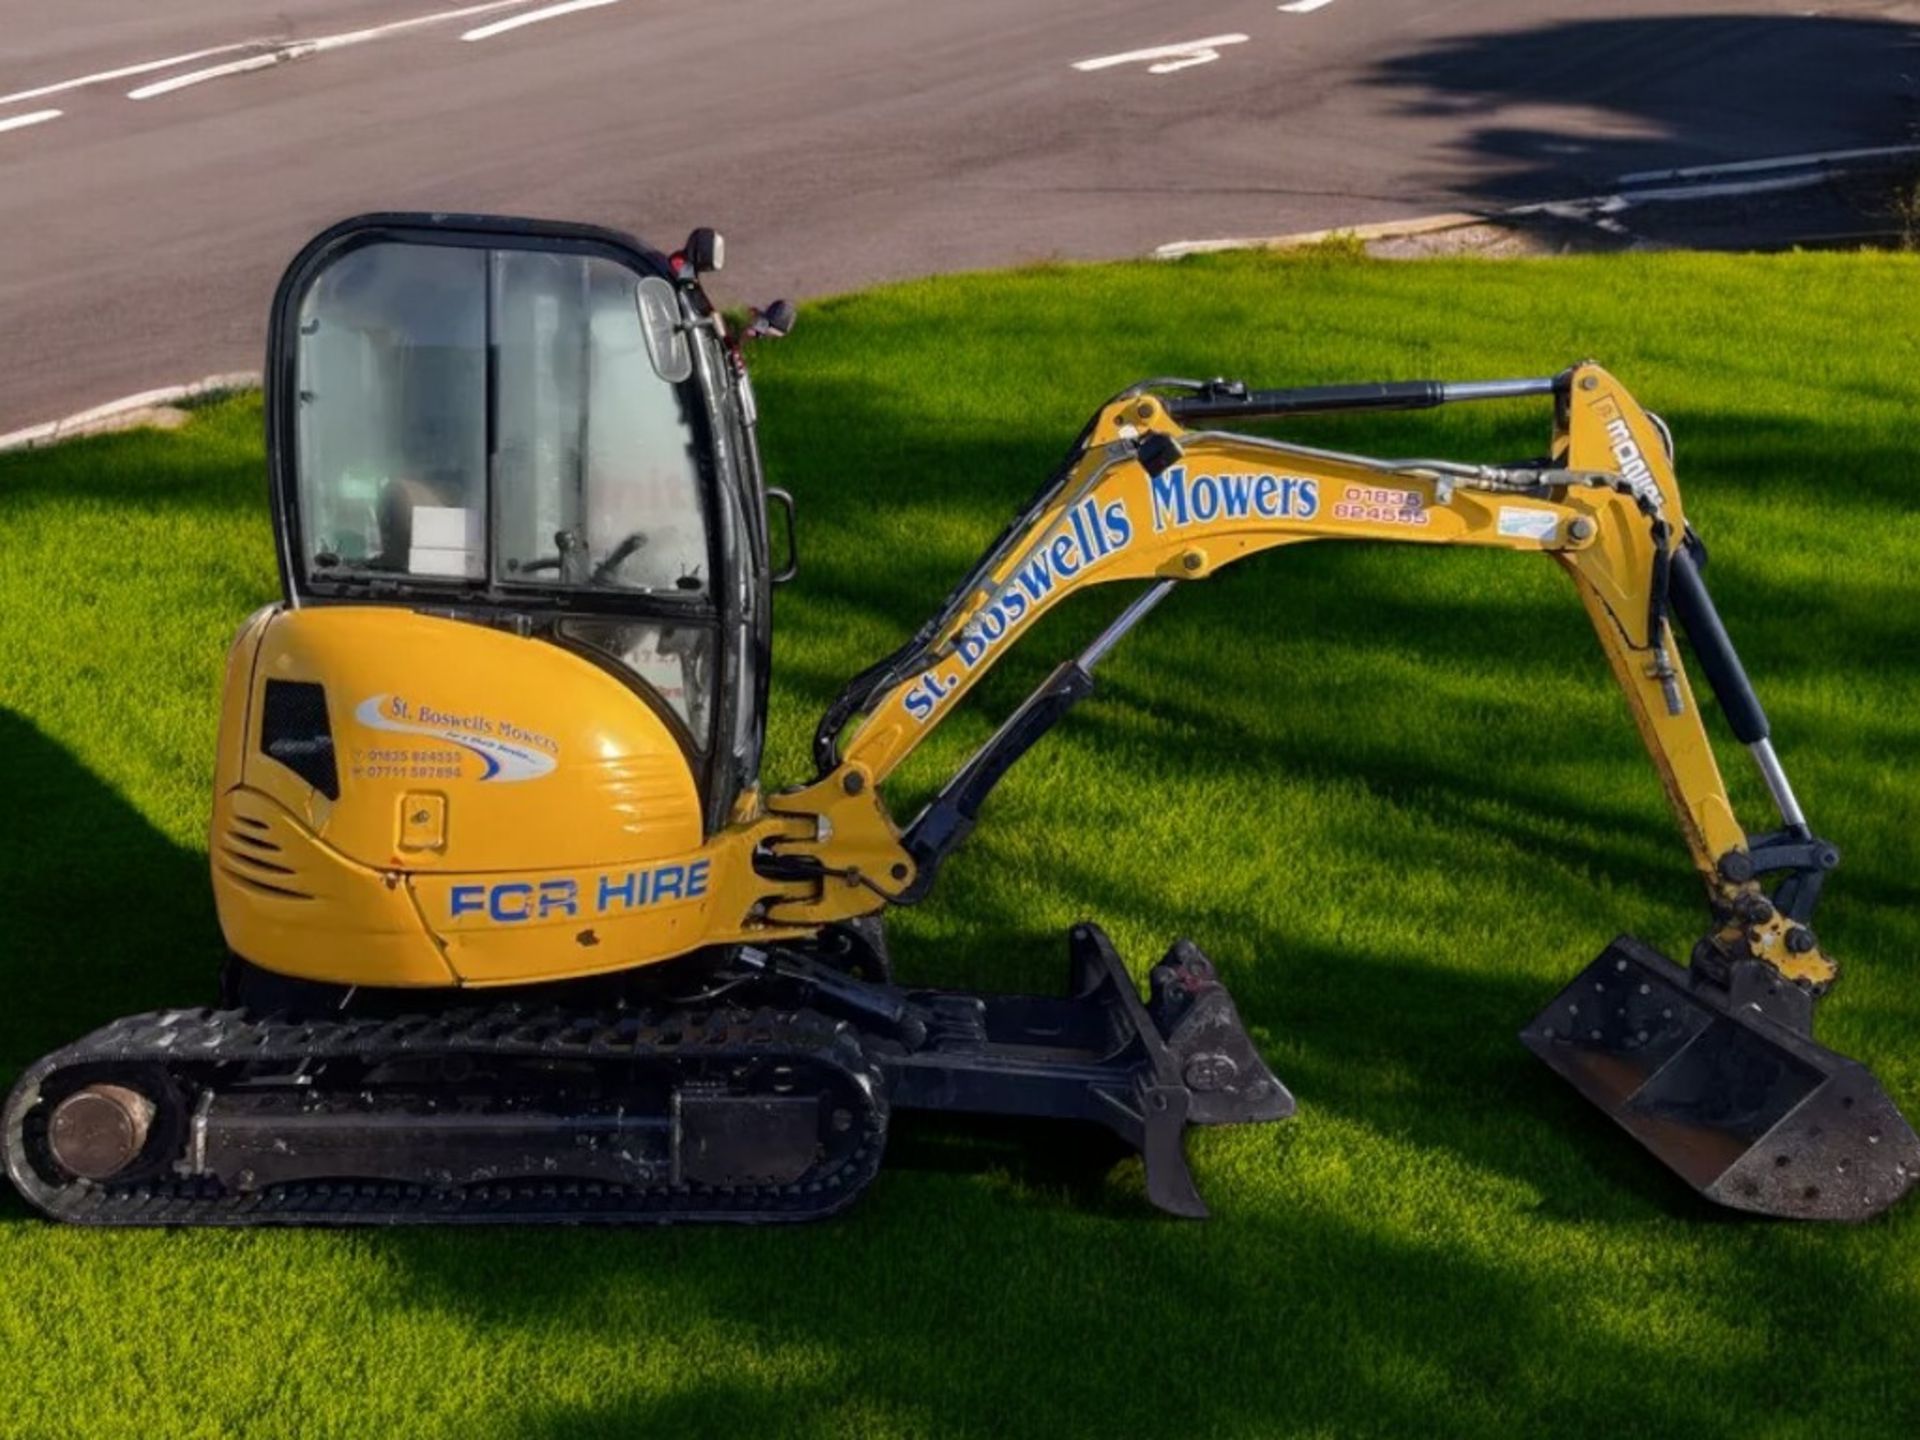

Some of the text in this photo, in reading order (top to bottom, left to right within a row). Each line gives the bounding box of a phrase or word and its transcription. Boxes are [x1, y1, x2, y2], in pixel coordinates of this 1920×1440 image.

[1333, 503, 1429, 525] 824555
[1345, 487, 1421, 507] 01835
[903, 466, 1319, 721] St. Boswells Mowers
[391, 697, 413, 721] St.
[418, 705, 493, 735] Boswells
[597, 859, 712, 913] HIRE
